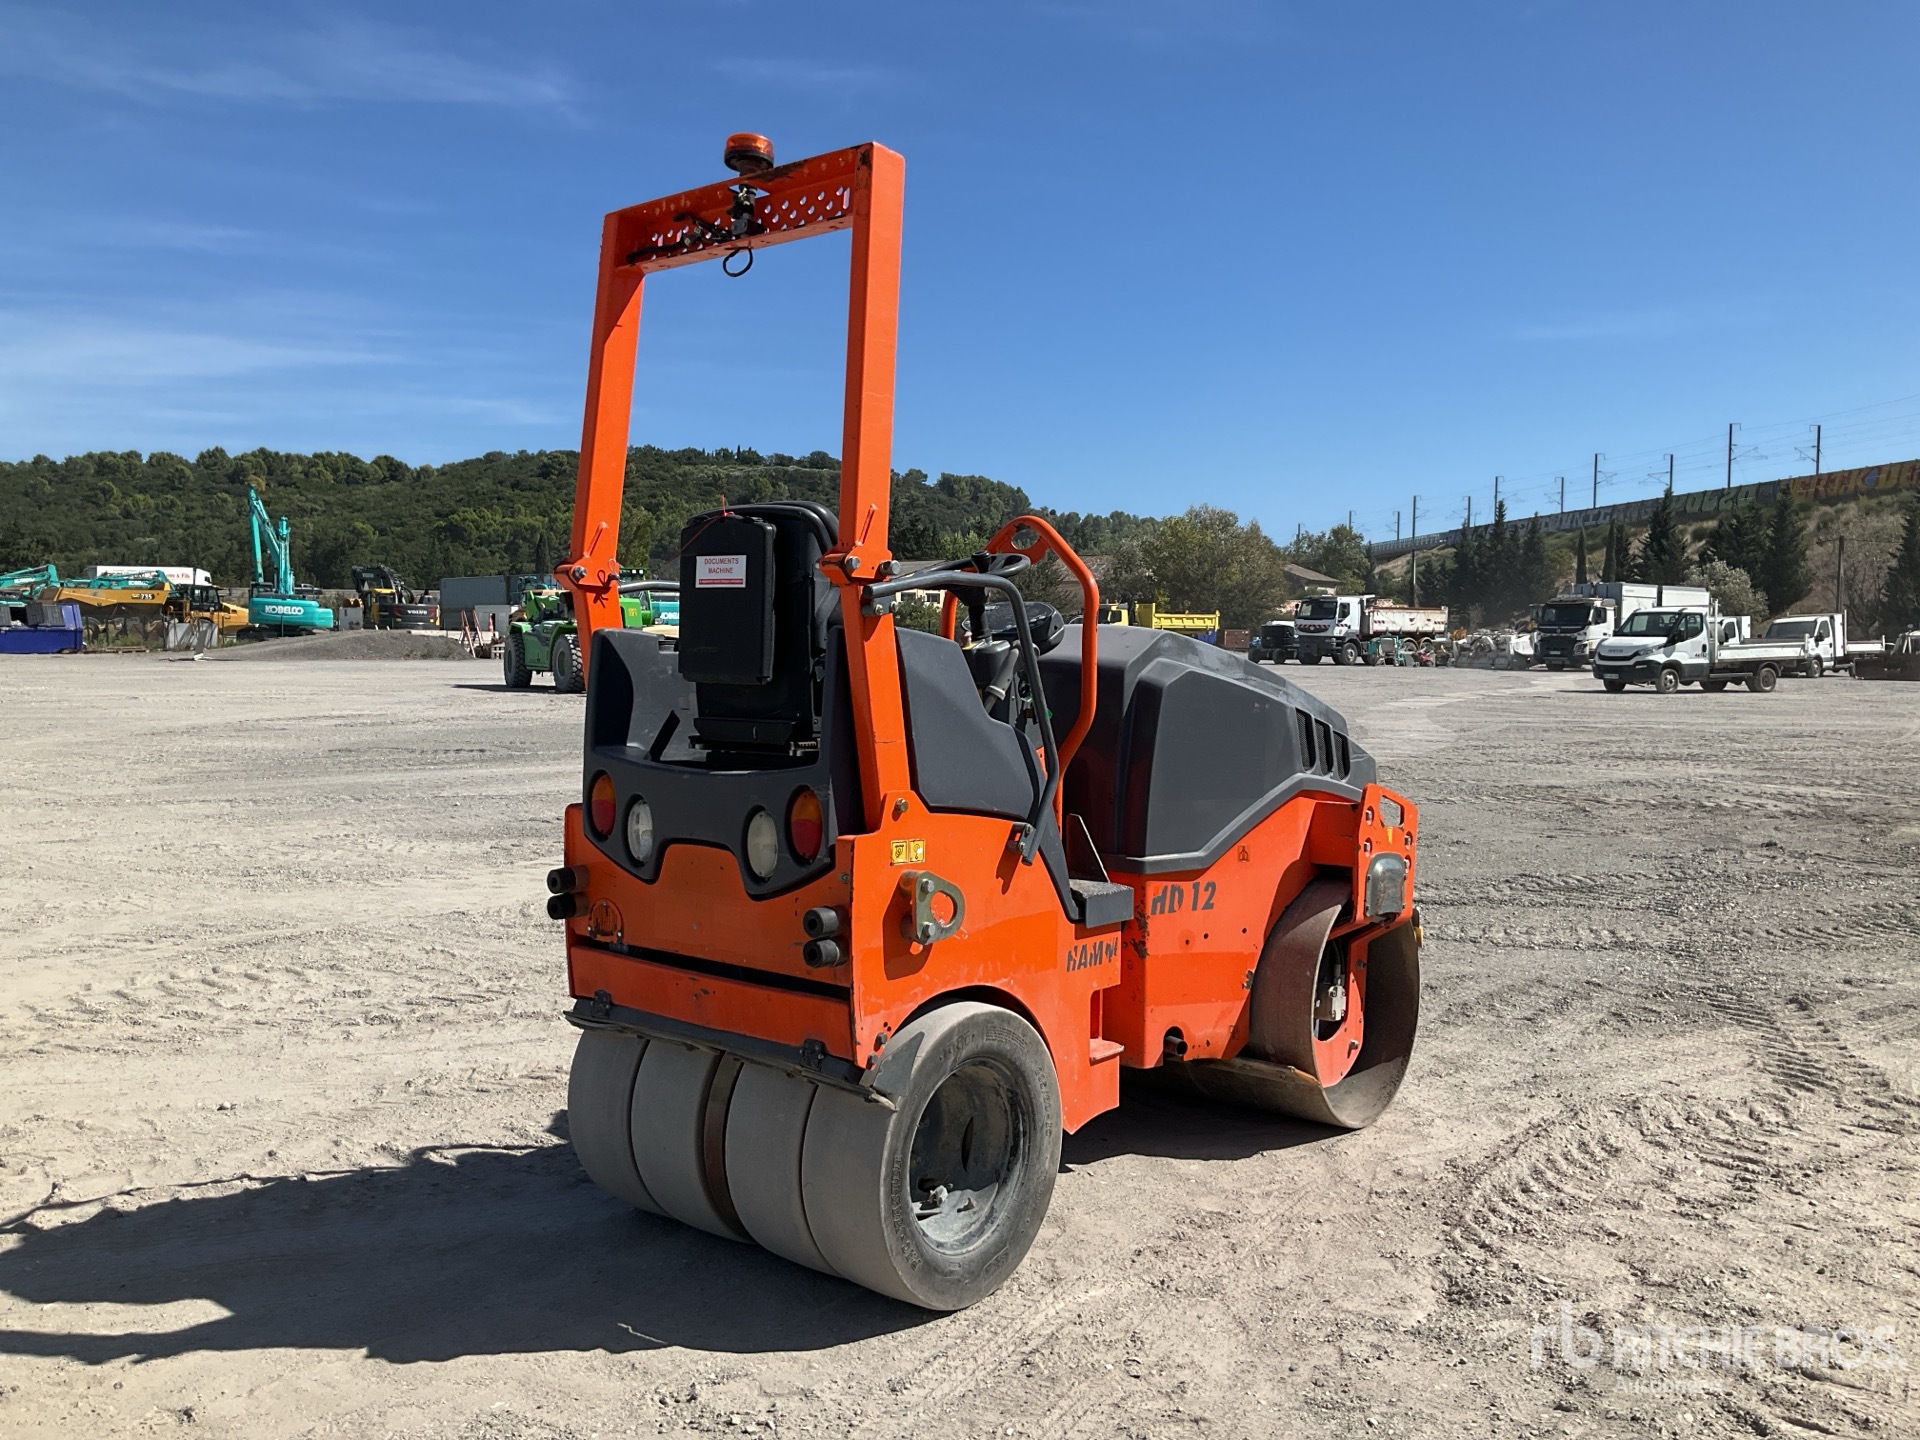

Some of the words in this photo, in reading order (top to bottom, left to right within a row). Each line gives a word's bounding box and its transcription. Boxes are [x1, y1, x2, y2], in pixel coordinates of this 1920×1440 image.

[704, 557, 739, 565] DOCUMENTS
[265, 604, 304, 615] KOBELCO
[1151, 884, 1184, 915] HD
[1191, 881, 1217, 911] 12
